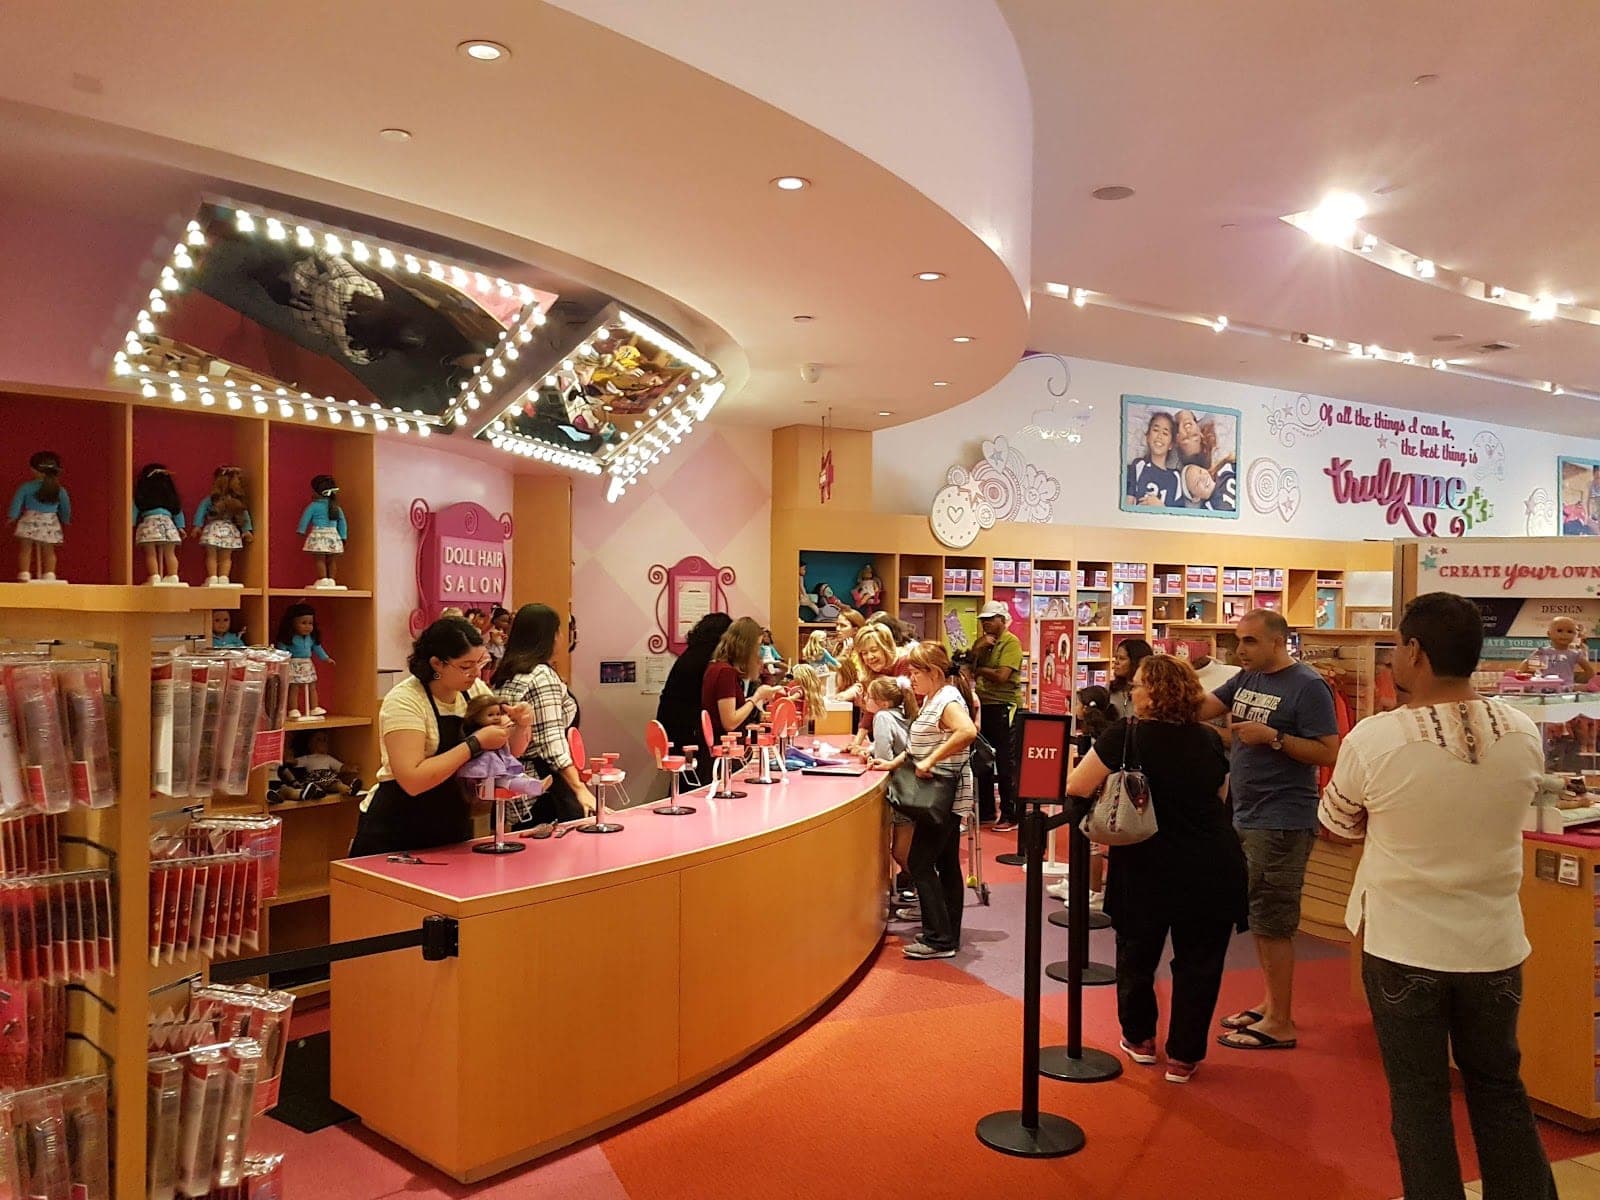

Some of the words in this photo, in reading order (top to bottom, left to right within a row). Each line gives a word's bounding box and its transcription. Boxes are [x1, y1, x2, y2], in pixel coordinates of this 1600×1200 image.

[1319, 402, 1333, 426] Of
[1336, 405, 1352, 424] all
[1355, 408, 1372, 428] the
[1374, 411, 1405, 436] things
[1420, 425, 1439, 437] can
[1401, 438, 1418, 457] the
[1419, 440, 1440, 459] best
[1442, 443, 1467, 467] thing
[1469, 448, 1478, 464] is
[445, 546, 476, 566] DOLL
[478, 550, 504, 568] HAIR
[444, 574, 502, 593] SALON
[1439, 565, 1501, 578] CREATE
[1503, 563, 1560, 590] your
[1562, 565, 1600, 579] OWN
[1541, 605, 1583, 615] DESIGN
[1508, 639, 1534, 647] YOUR
[1028, 747, 1057, 759] EXIT
